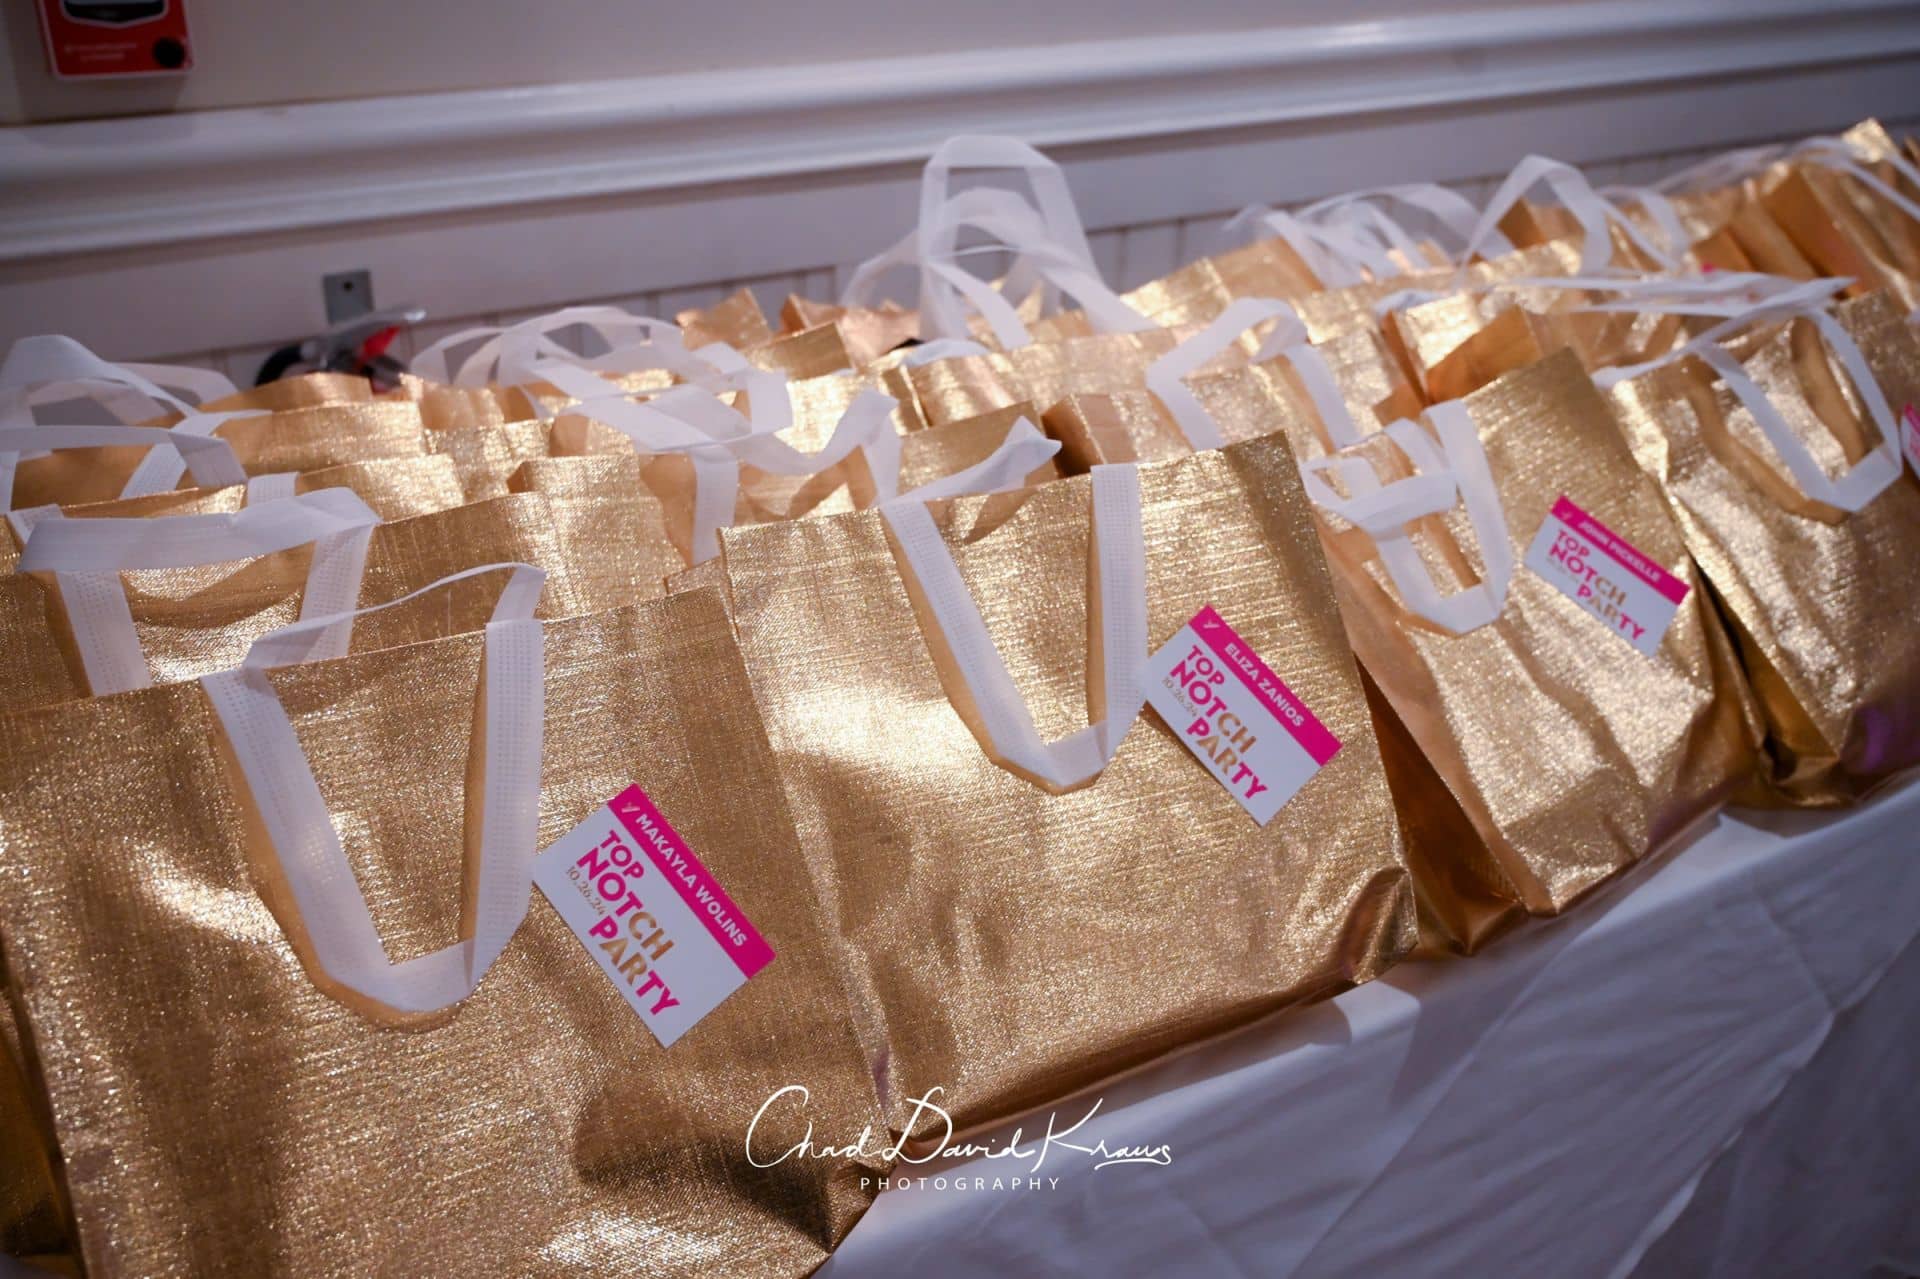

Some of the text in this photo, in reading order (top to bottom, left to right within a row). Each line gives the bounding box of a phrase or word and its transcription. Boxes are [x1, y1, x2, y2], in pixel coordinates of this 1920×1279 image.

[1548, 544, 1627, 606] NOTCH
[1556, 530, 1591, 558] TOP
[1577, 584, 1646, 641] PARTY
[1186, 645, 1225, 686] TOP
[1224, 642, 1305, 728] ELIZA ZANIOS
[1170, 661, 1257, 754] NOTCH
[1186, 717, 1268, 799] PARTY
[565, 866, 605, 916] 10.26.24
[600, 830, 645, 880] TOP
[635, 813, 748, 947] MAKAYLA WOLINS
[576, 847, 675, 962] NOTCH
[588, 915, 681, 1016] PARTY
